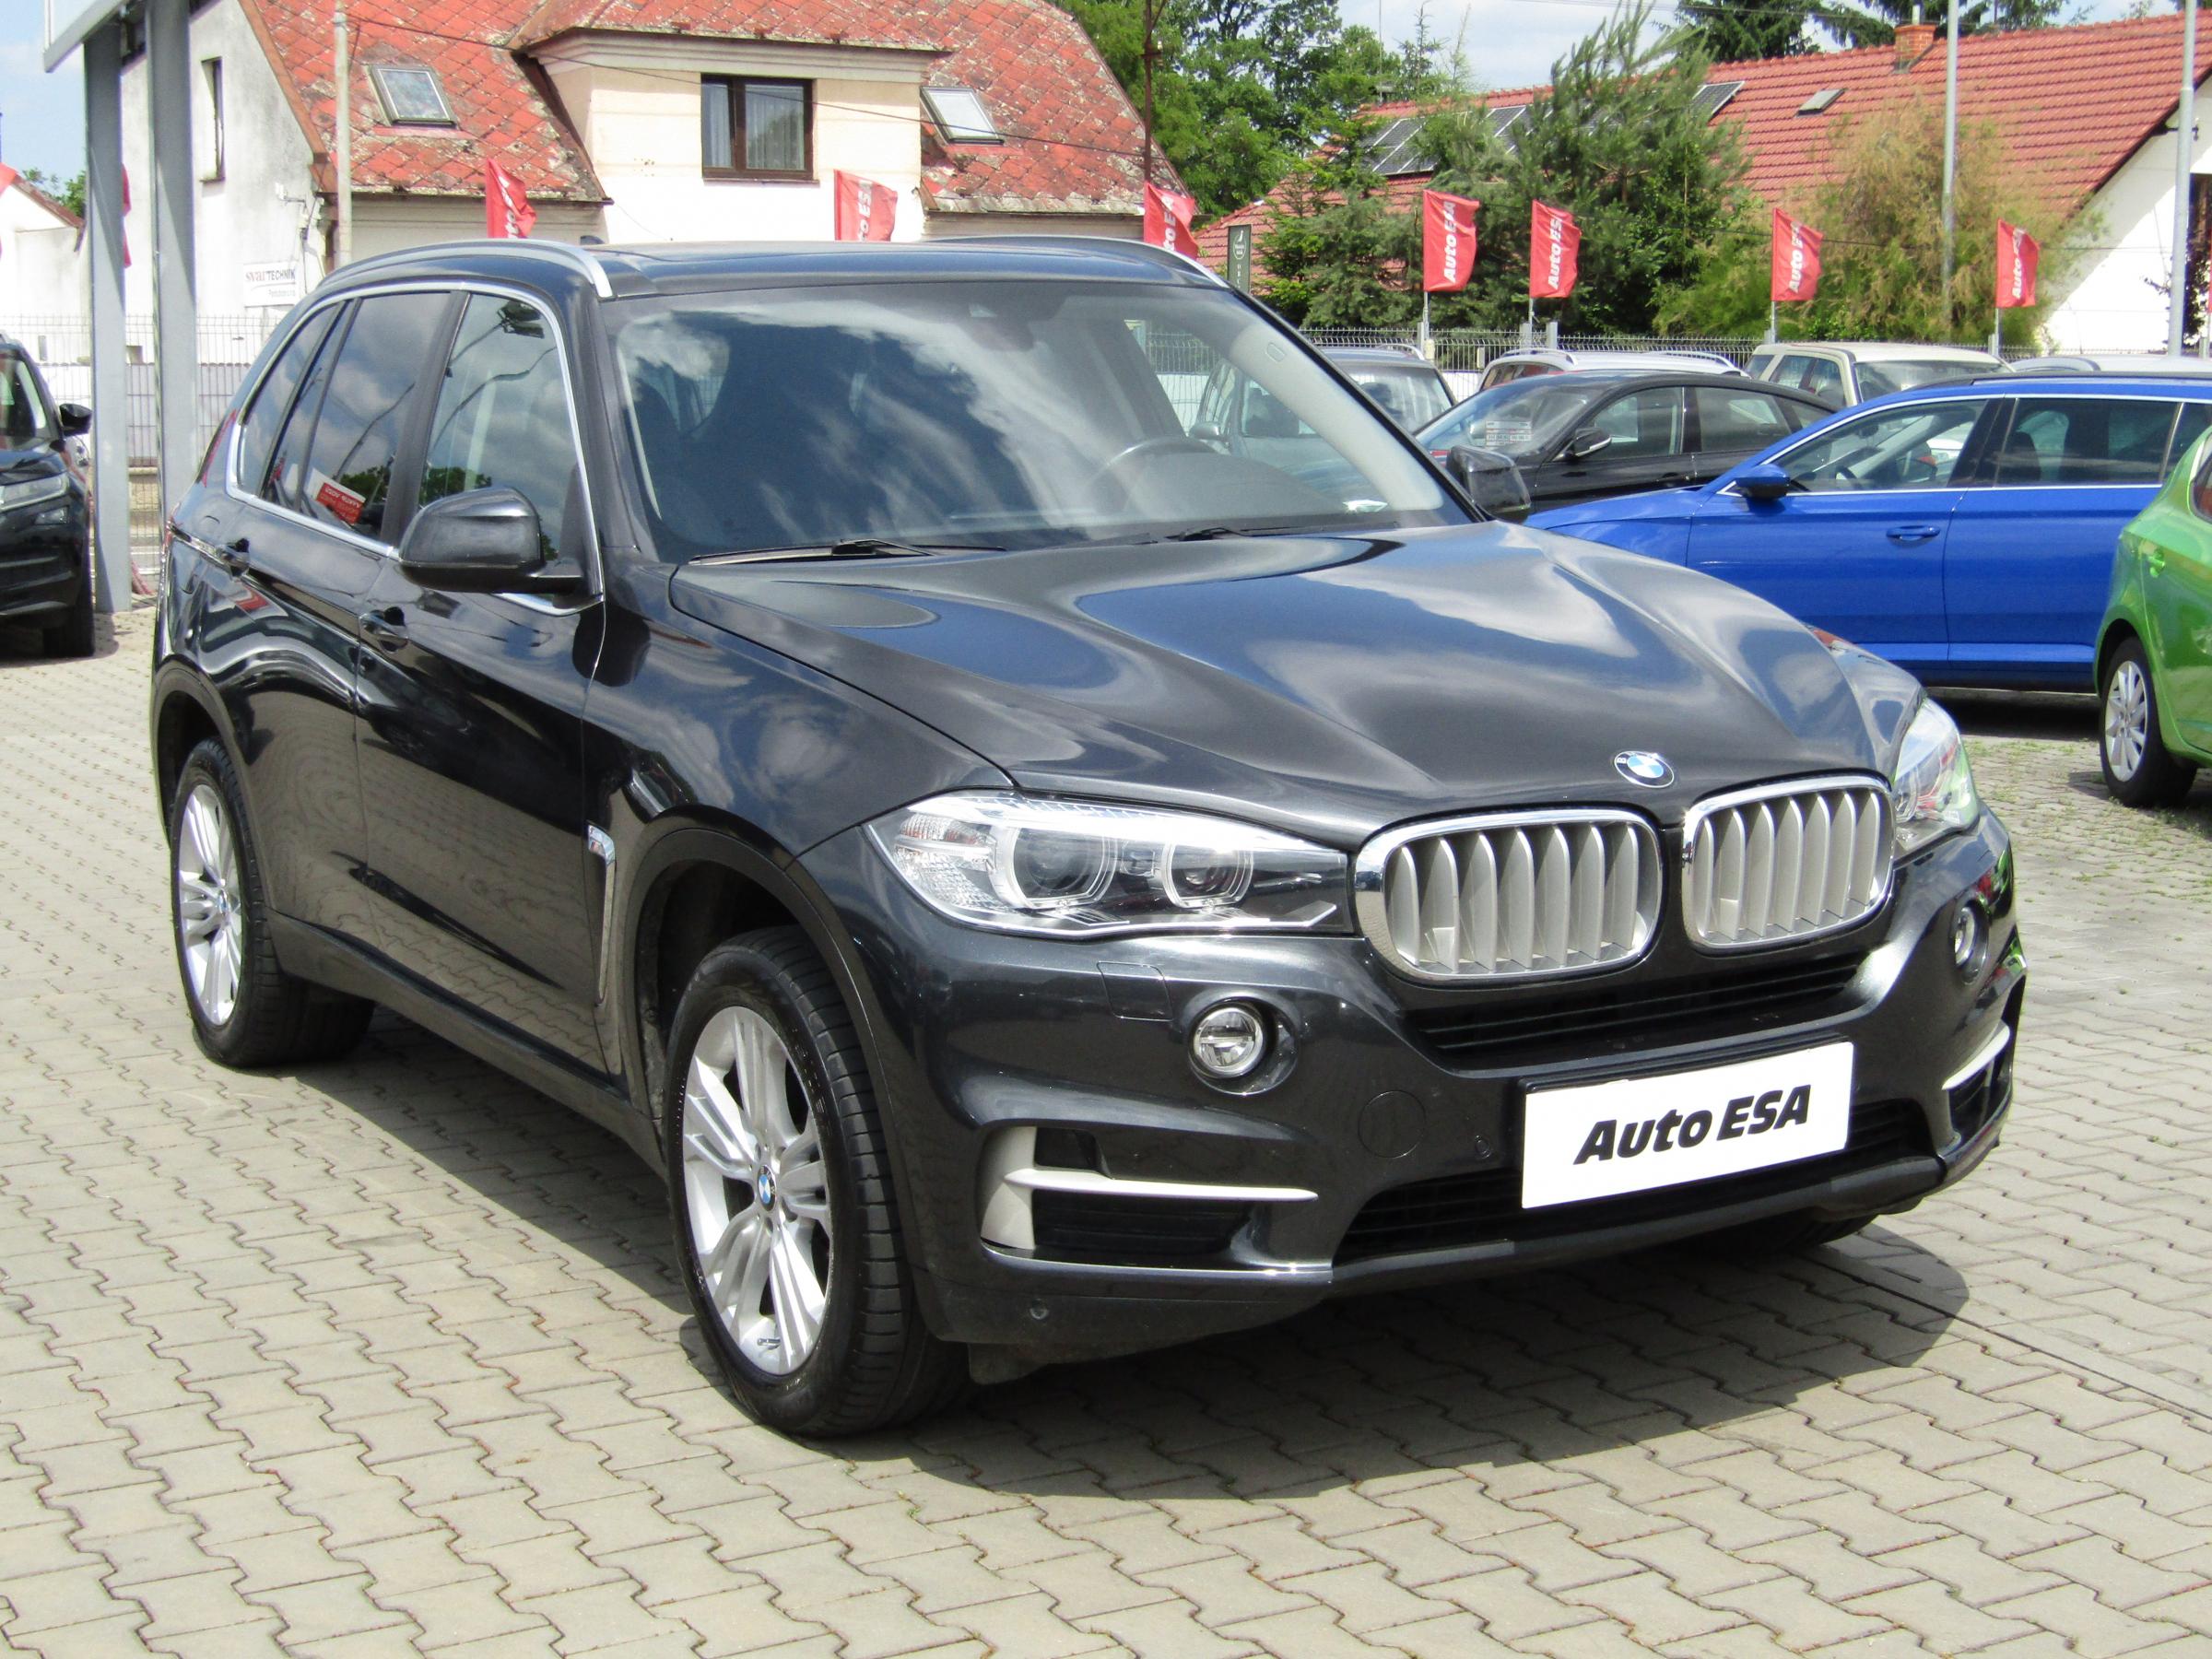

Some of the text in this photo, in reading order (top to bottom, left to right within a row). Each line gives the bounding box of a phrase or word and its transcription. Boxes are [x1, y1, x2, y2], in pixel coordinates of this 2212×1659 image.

[1443, 234, 1457, 284] Auto
[1547, 216, 1563, 290] Auto ES
[1789, 249, 1804, 294] Auto
[2012, 257, 2022, 300] Auto
[1573, 1084, 1811, 1165] Auto ESA
